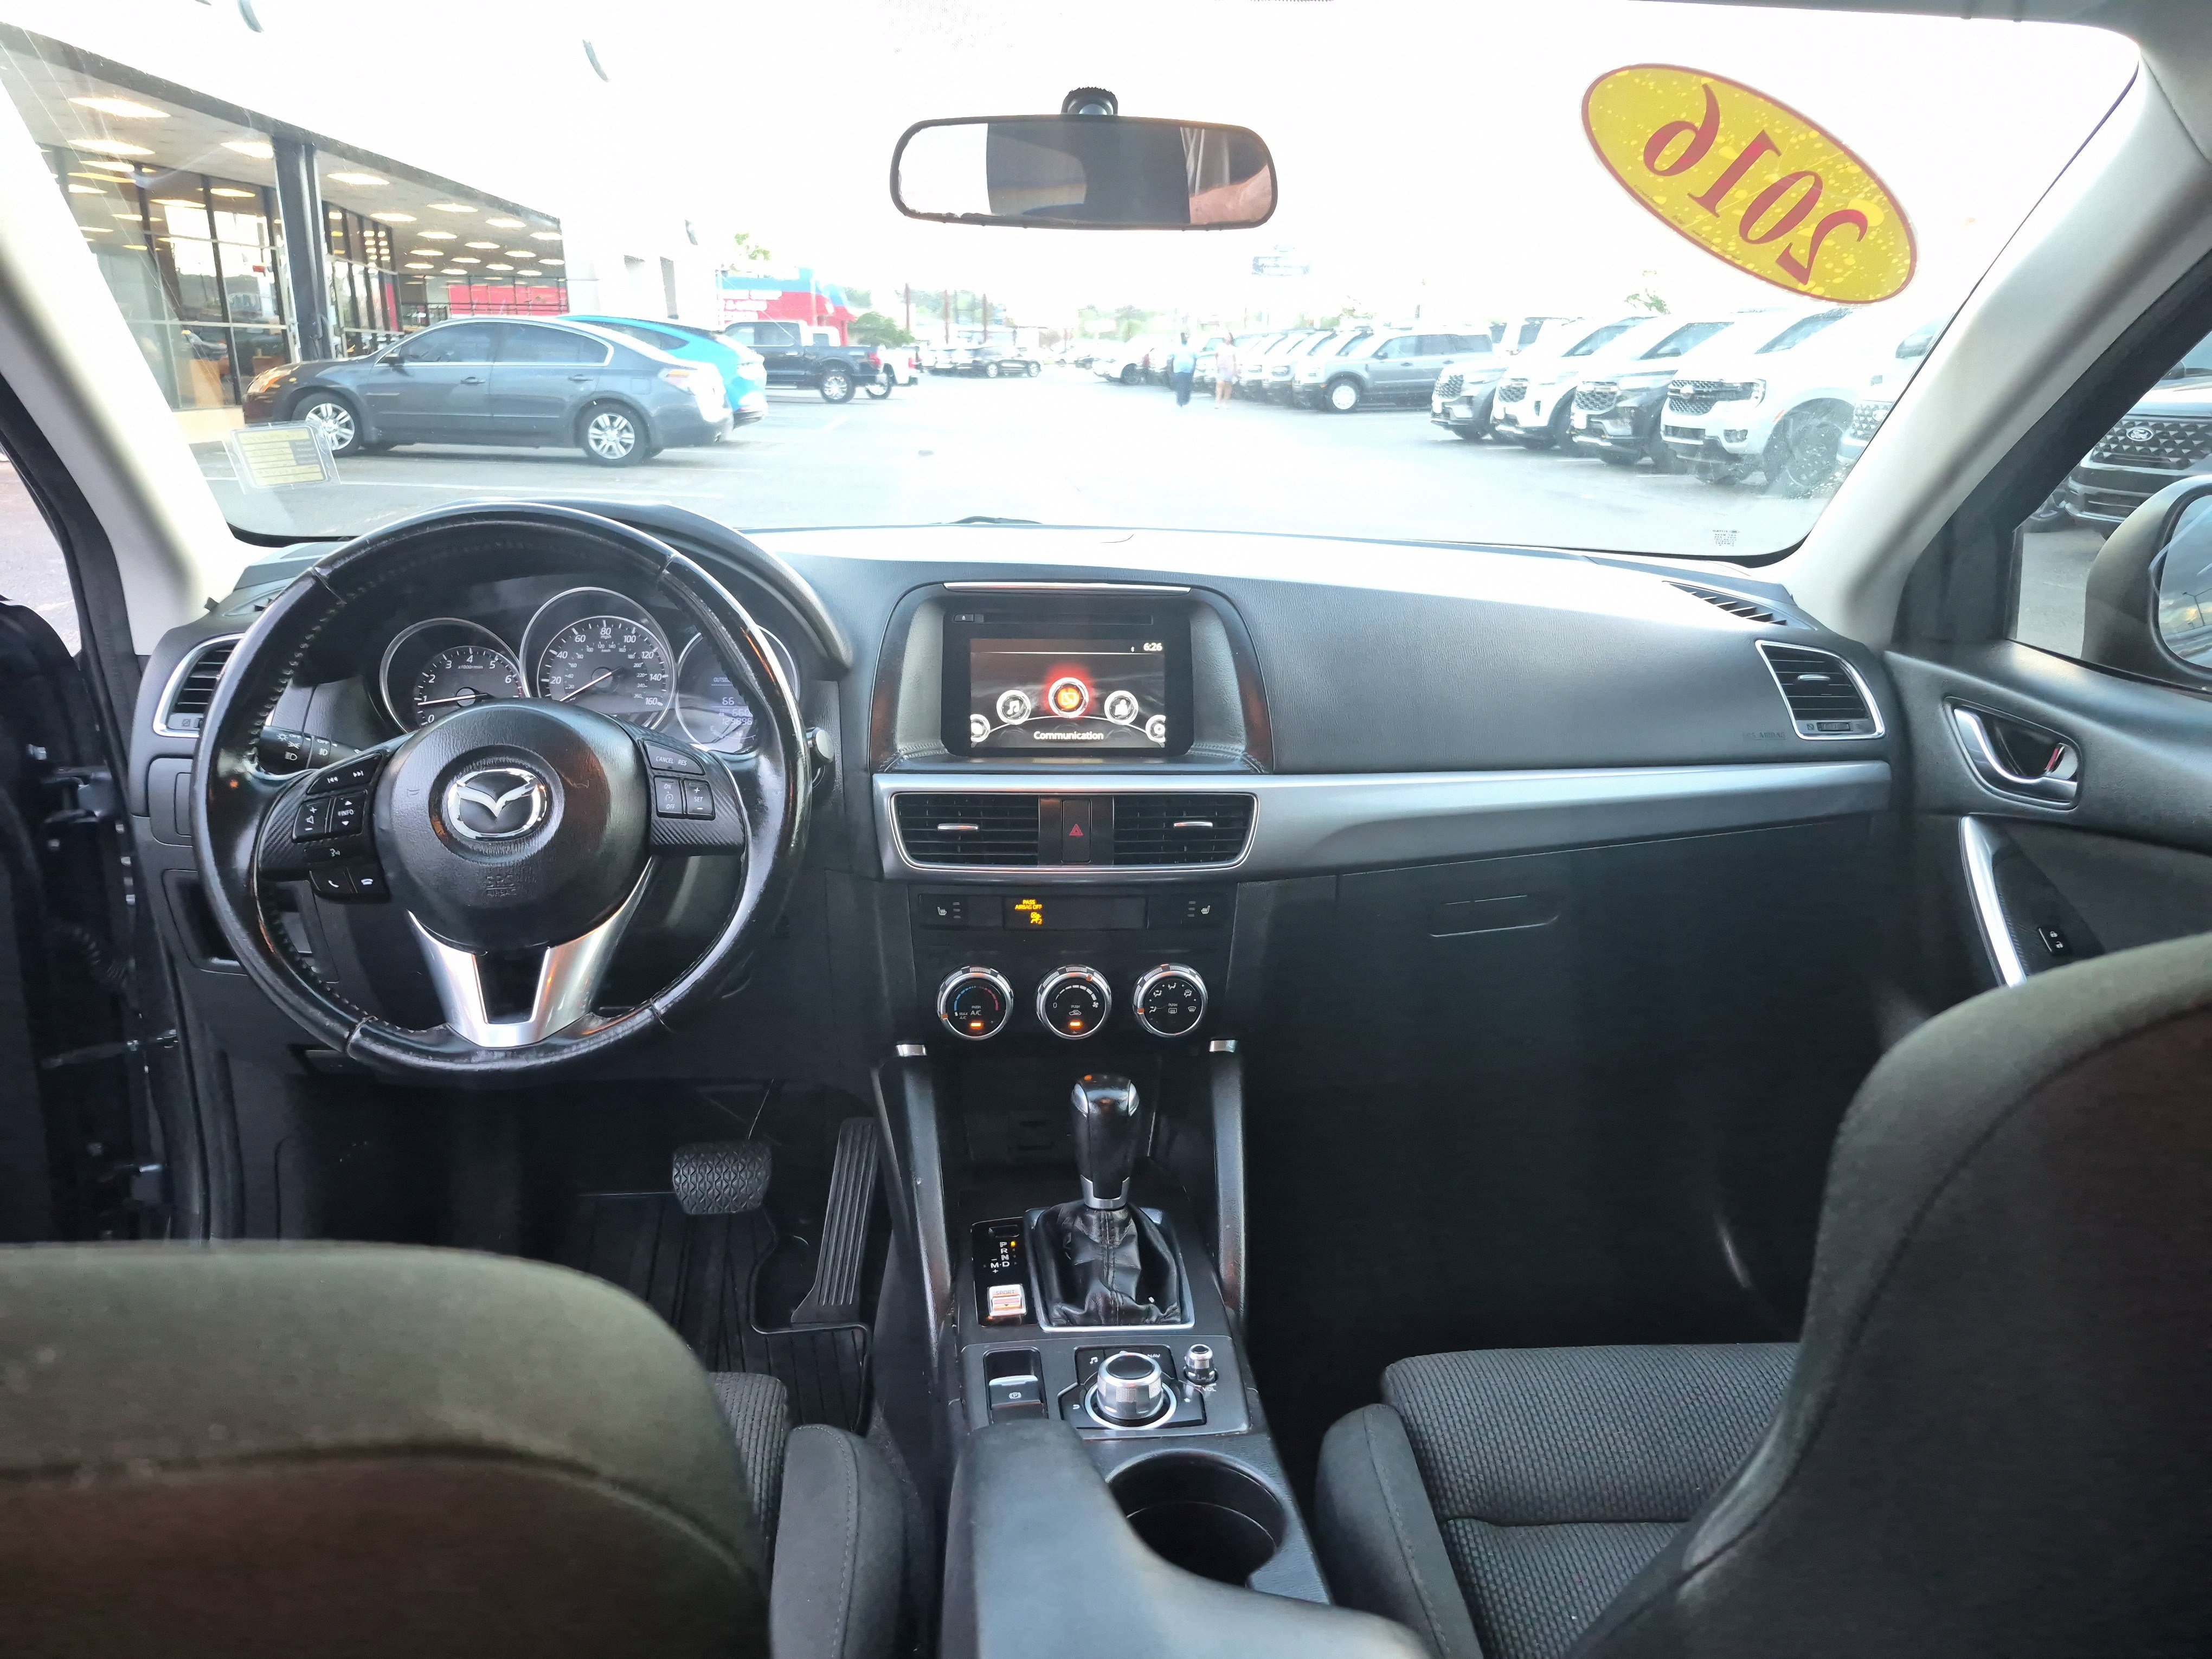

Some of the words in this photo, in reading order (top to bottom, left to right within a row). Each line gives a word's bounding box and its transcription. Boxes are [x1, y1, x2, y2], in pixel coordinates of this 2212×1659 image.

[600, 627, 612, 635] 80
[623, 635, 636, 643] 100
[1143, 642, 1162, 651] 6:26
[466, 654, 474, 663] 4
[445, 660, 452, 668] 3
[489, 660, 496, 669] 5
[428, 674, 436, 683] 2
[505, 674, 512, 684] 6
[550, 676, 562, 684] 20
[650, 673, 662, 681] 140
[722, 697, 735, 705] 66
[428, 714, 435, 723] 0
[1034, 731, 1104, 740] Communication
[656, 756, 673, 764] CANCEL
